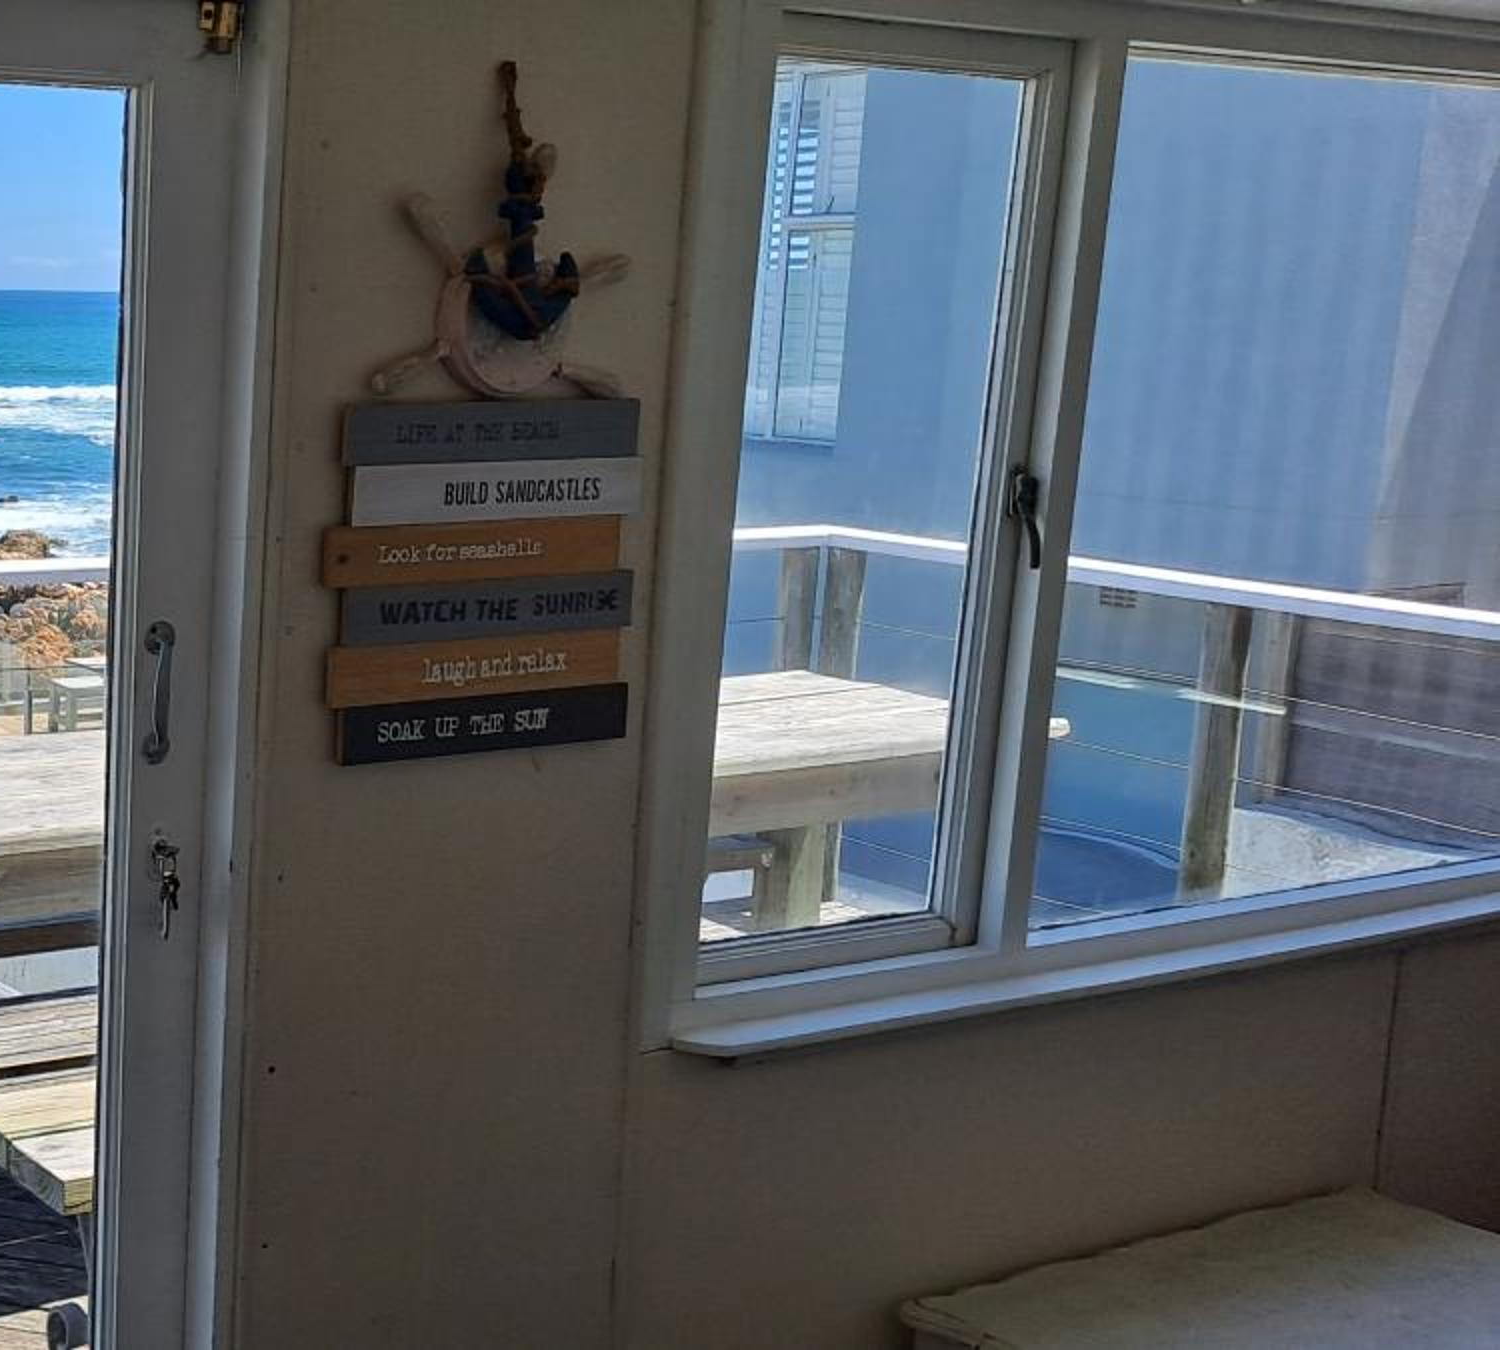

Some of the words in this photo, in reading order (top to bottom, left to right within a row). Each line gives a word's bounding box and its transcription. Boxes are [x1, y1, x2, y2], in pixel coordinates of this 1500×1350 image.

[444, 481, 489, 506] BUILD
[495, 477, 601, 503] SANDCASTLES
[377, 545, 421, 564] Look
[426, 543, 457, 562] for
[459, 537, 543, 560] seashells
[378, 600, 466, 625] WATCH
[474, 597, 518, 621] THE
[532, 588, 620, 617] SUNRISE
[421, 656, 475, 687] laugh
[479, 652, 513, 678] and
[516, 650, 568, 674] relax
[377, 718, 426, 743] SOAK
[435, 716, 460, 738] UP
[470, 713, 504, 736] THE
[514, 707, 550, 732] SUN
